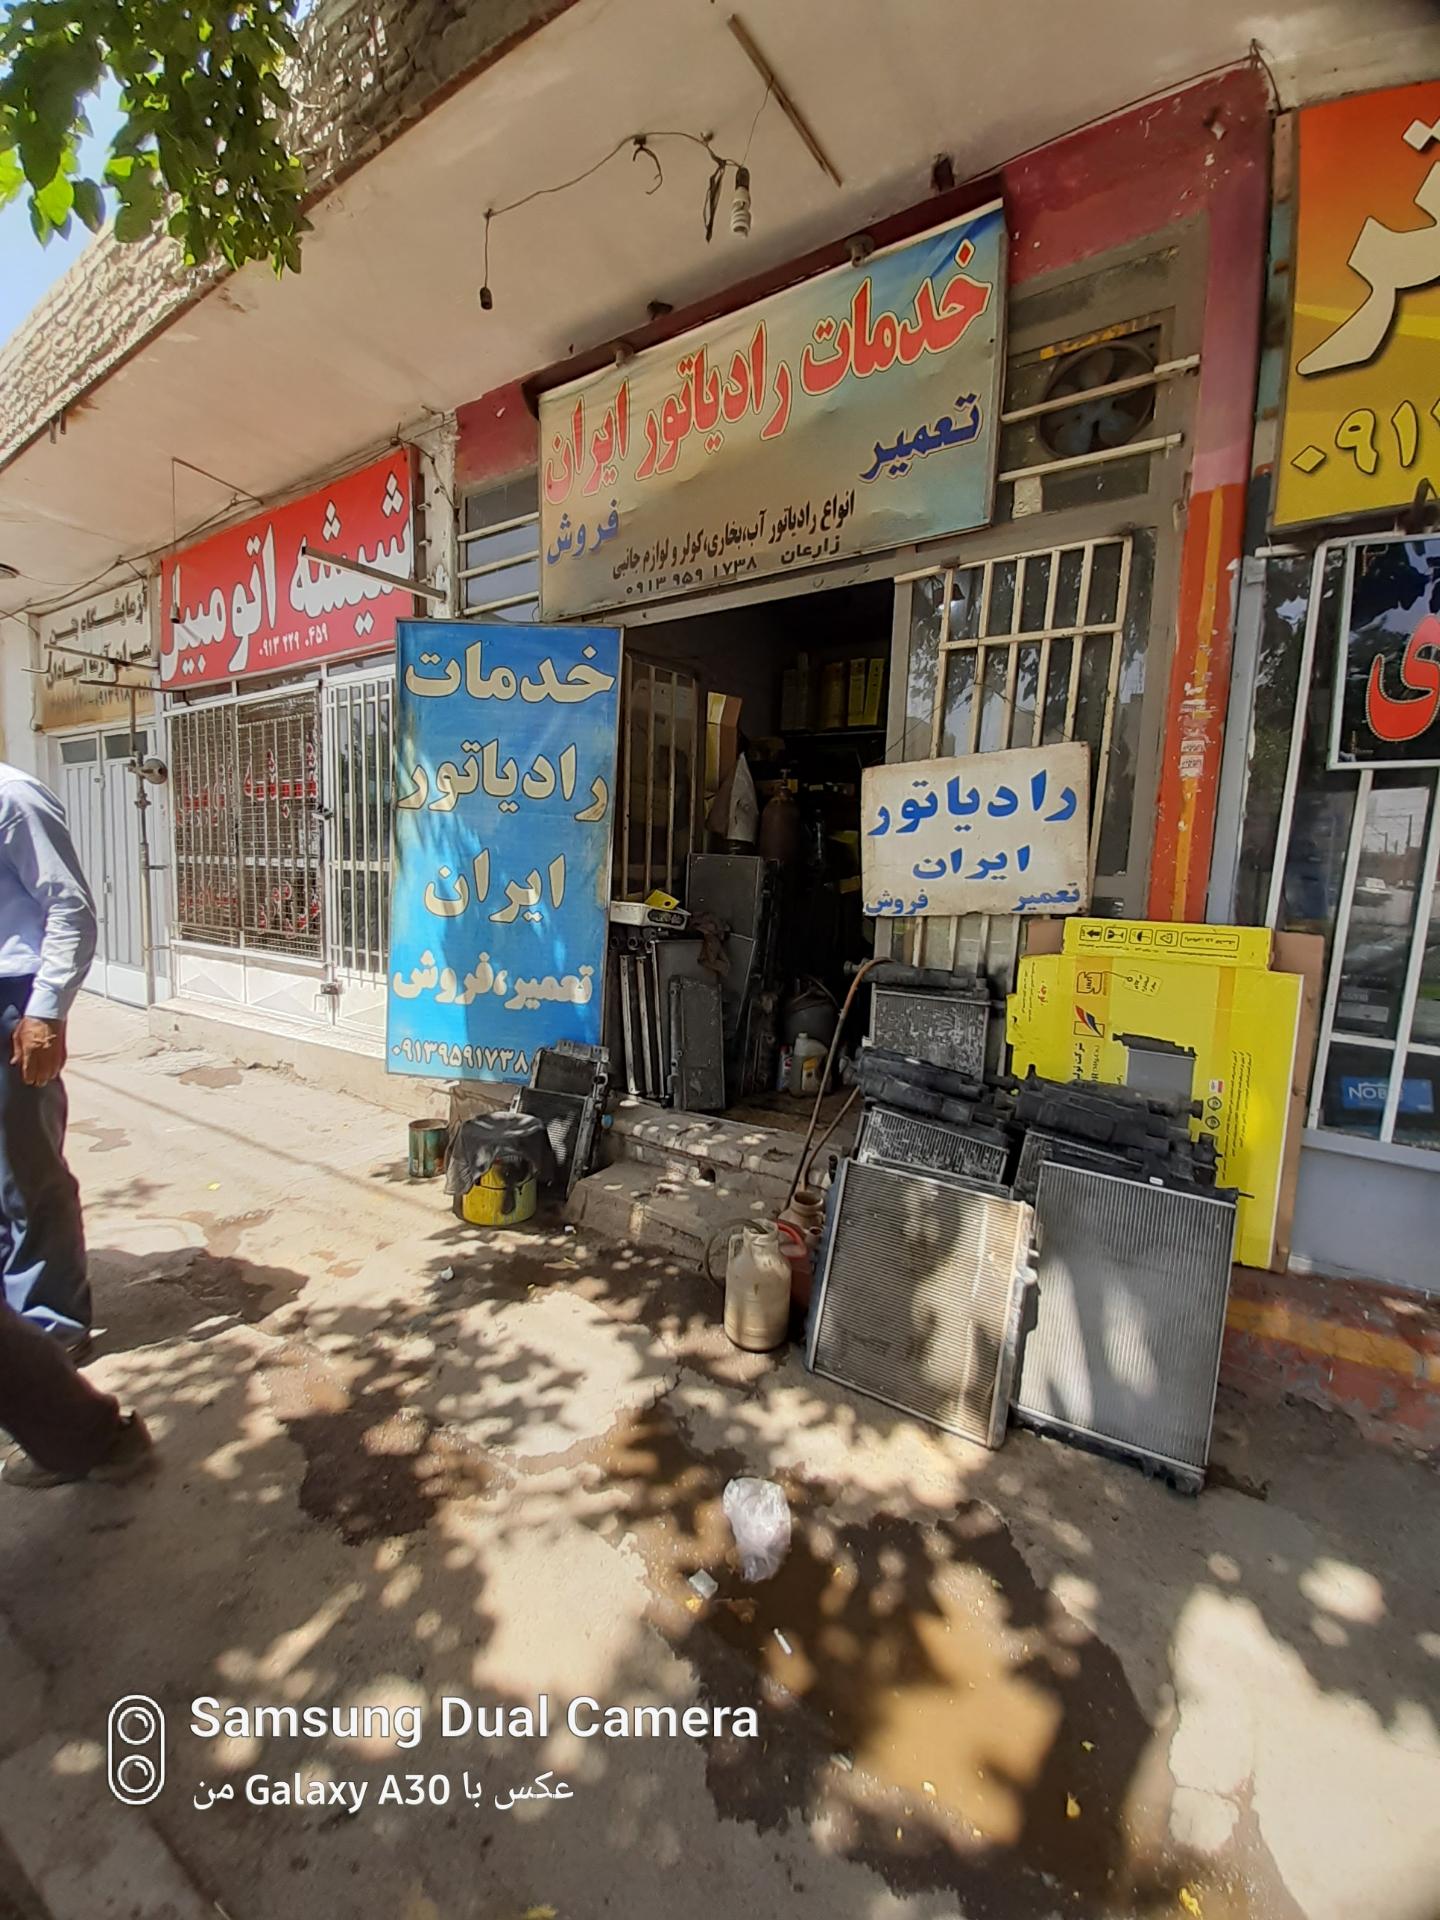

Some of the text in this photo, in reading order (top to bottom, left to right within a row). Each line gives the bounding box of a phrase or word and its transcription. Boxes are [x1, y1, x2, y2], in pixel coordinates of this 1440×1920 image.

[544, 240, 994, 504] خدمات رادیاتور ایران
[860, 392, 982, 482] تعمیر
[1291, 400, 1440, 475] ۰۹۱
[768, 500, 817, 544] رادیاتور
[820, 488, 856, 530] انواع
[546, 499, 620, 564] فروش
[780, 535, 840, 565] زارعان
[160, 471, 412, 682] شیشه اتومبیل
[612, 547, 641, 579] جانبی
[626, 556, 757, 594] ۰۹۱۳ ۹۵۹ ۱۷۳۸
[642, 538, 670, 575] لوازم
[670, 544, 679, 567] و
[404, 640, 616, 703] خدمات
[399, 738, 609, 821] رادیاتور
[867, 769, 1078, 836] رادیاتور
[912, 845, 1031, 880] ایران
[423, 848, 566, 924] ایران
[865, 883, 1081, 914] تعمیر فروش
[393, 1040, 529, 1077] ۰۹۱۳۹۵۹۱۷۳۸
